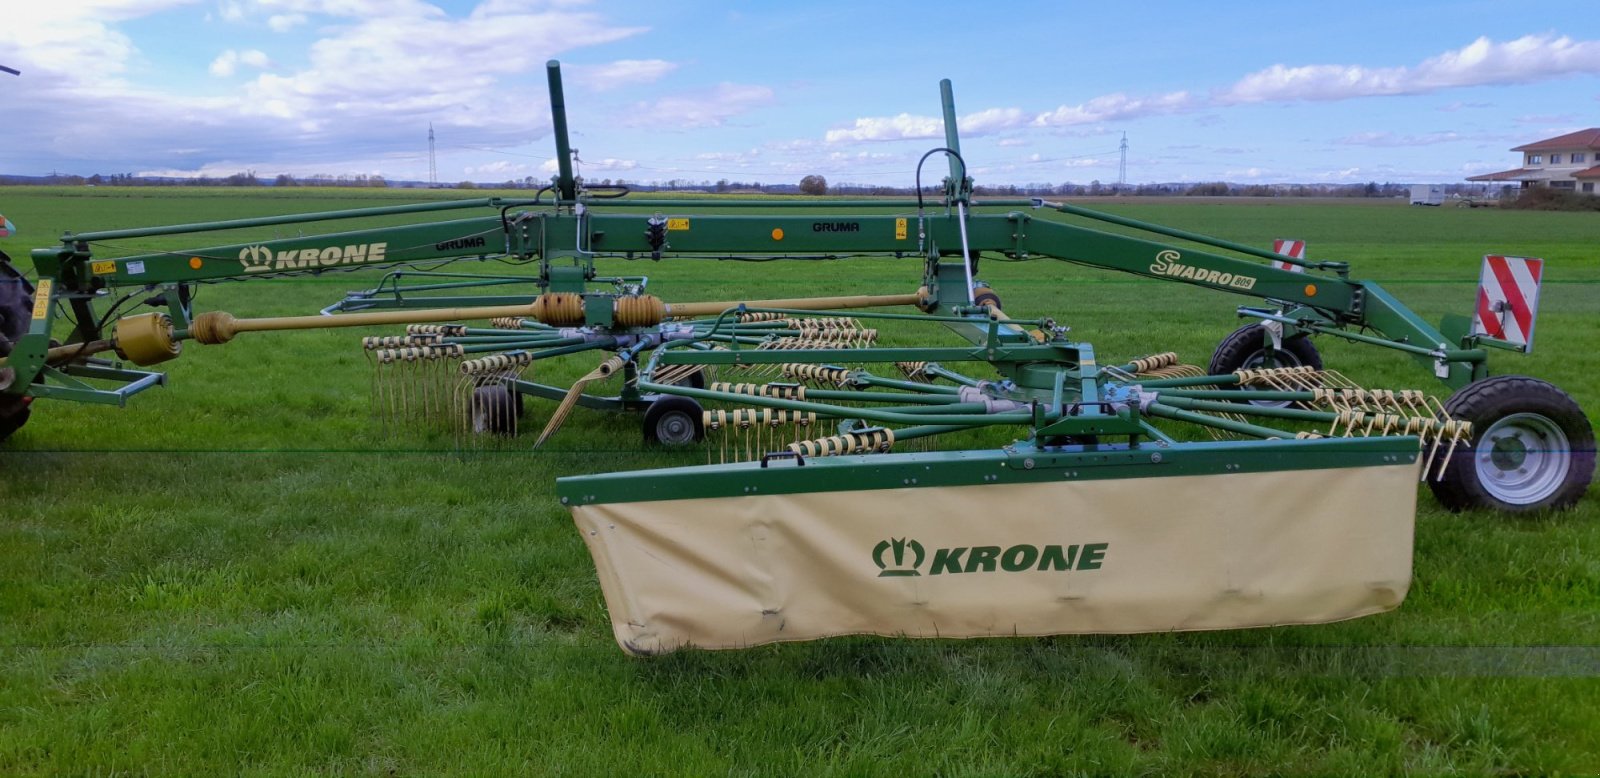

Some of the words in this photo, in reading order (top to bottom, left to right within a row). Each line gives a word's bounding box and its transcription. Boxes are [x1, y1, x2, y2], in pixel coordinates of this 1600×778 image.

[812, 222, 860, 233] GRUMA
[275, 242, 388, 270] KRONE
[435, 236, 485, 251] GRUMA
[1149, 249, 1233, 285] SWADRO
[1233, 275, 1253, 288] 809
[929, 542, 1109, 576] KRONE
